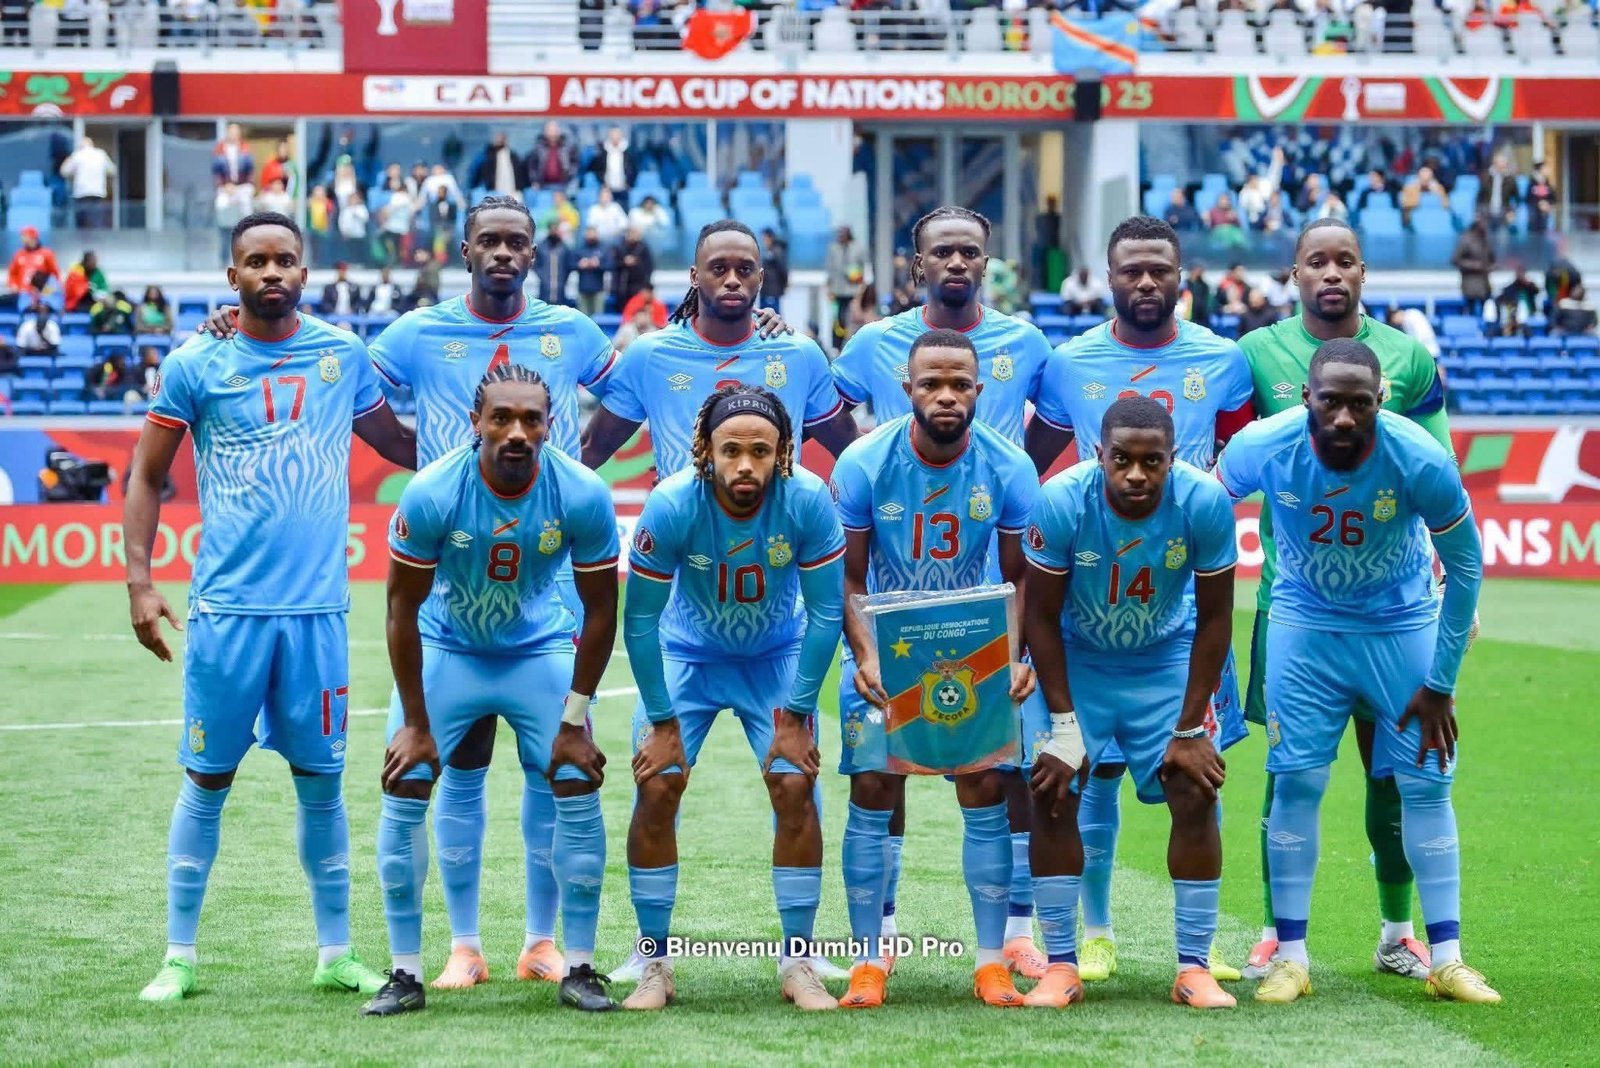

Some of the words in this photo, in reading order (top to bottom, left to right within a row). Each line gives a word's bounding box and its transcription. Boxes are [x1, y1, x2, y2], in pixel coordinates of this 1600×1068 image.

[435, 83, 526, 103] CAF
[559, 77, 682, 109] AFRICA
[681, 78, 749, 110] CUP
[751, 79, 798, 110] OF
[803, 79, 945, 110] NATIONS
[946, 80, 1111, 111] MOROC
[1117, 81, 1153, 110] 25
[261, 375, 306, 423] 17
[727, 399, 776, 418] KIPRUN
[2, 522, 203, 568] MOROC
[912, 512, 960, 561] 13
[1309, 504, 1365, 547] 26
[486, 542, 521, 583] 8
[717, 562, 765, 604] 10
[1108, 562, 1155, 607] 14
[900, 622, 940, 633] REPUBLIQUE
[923, 630, 936, 640] DU
[936, 627, 966, 639] CONGO
